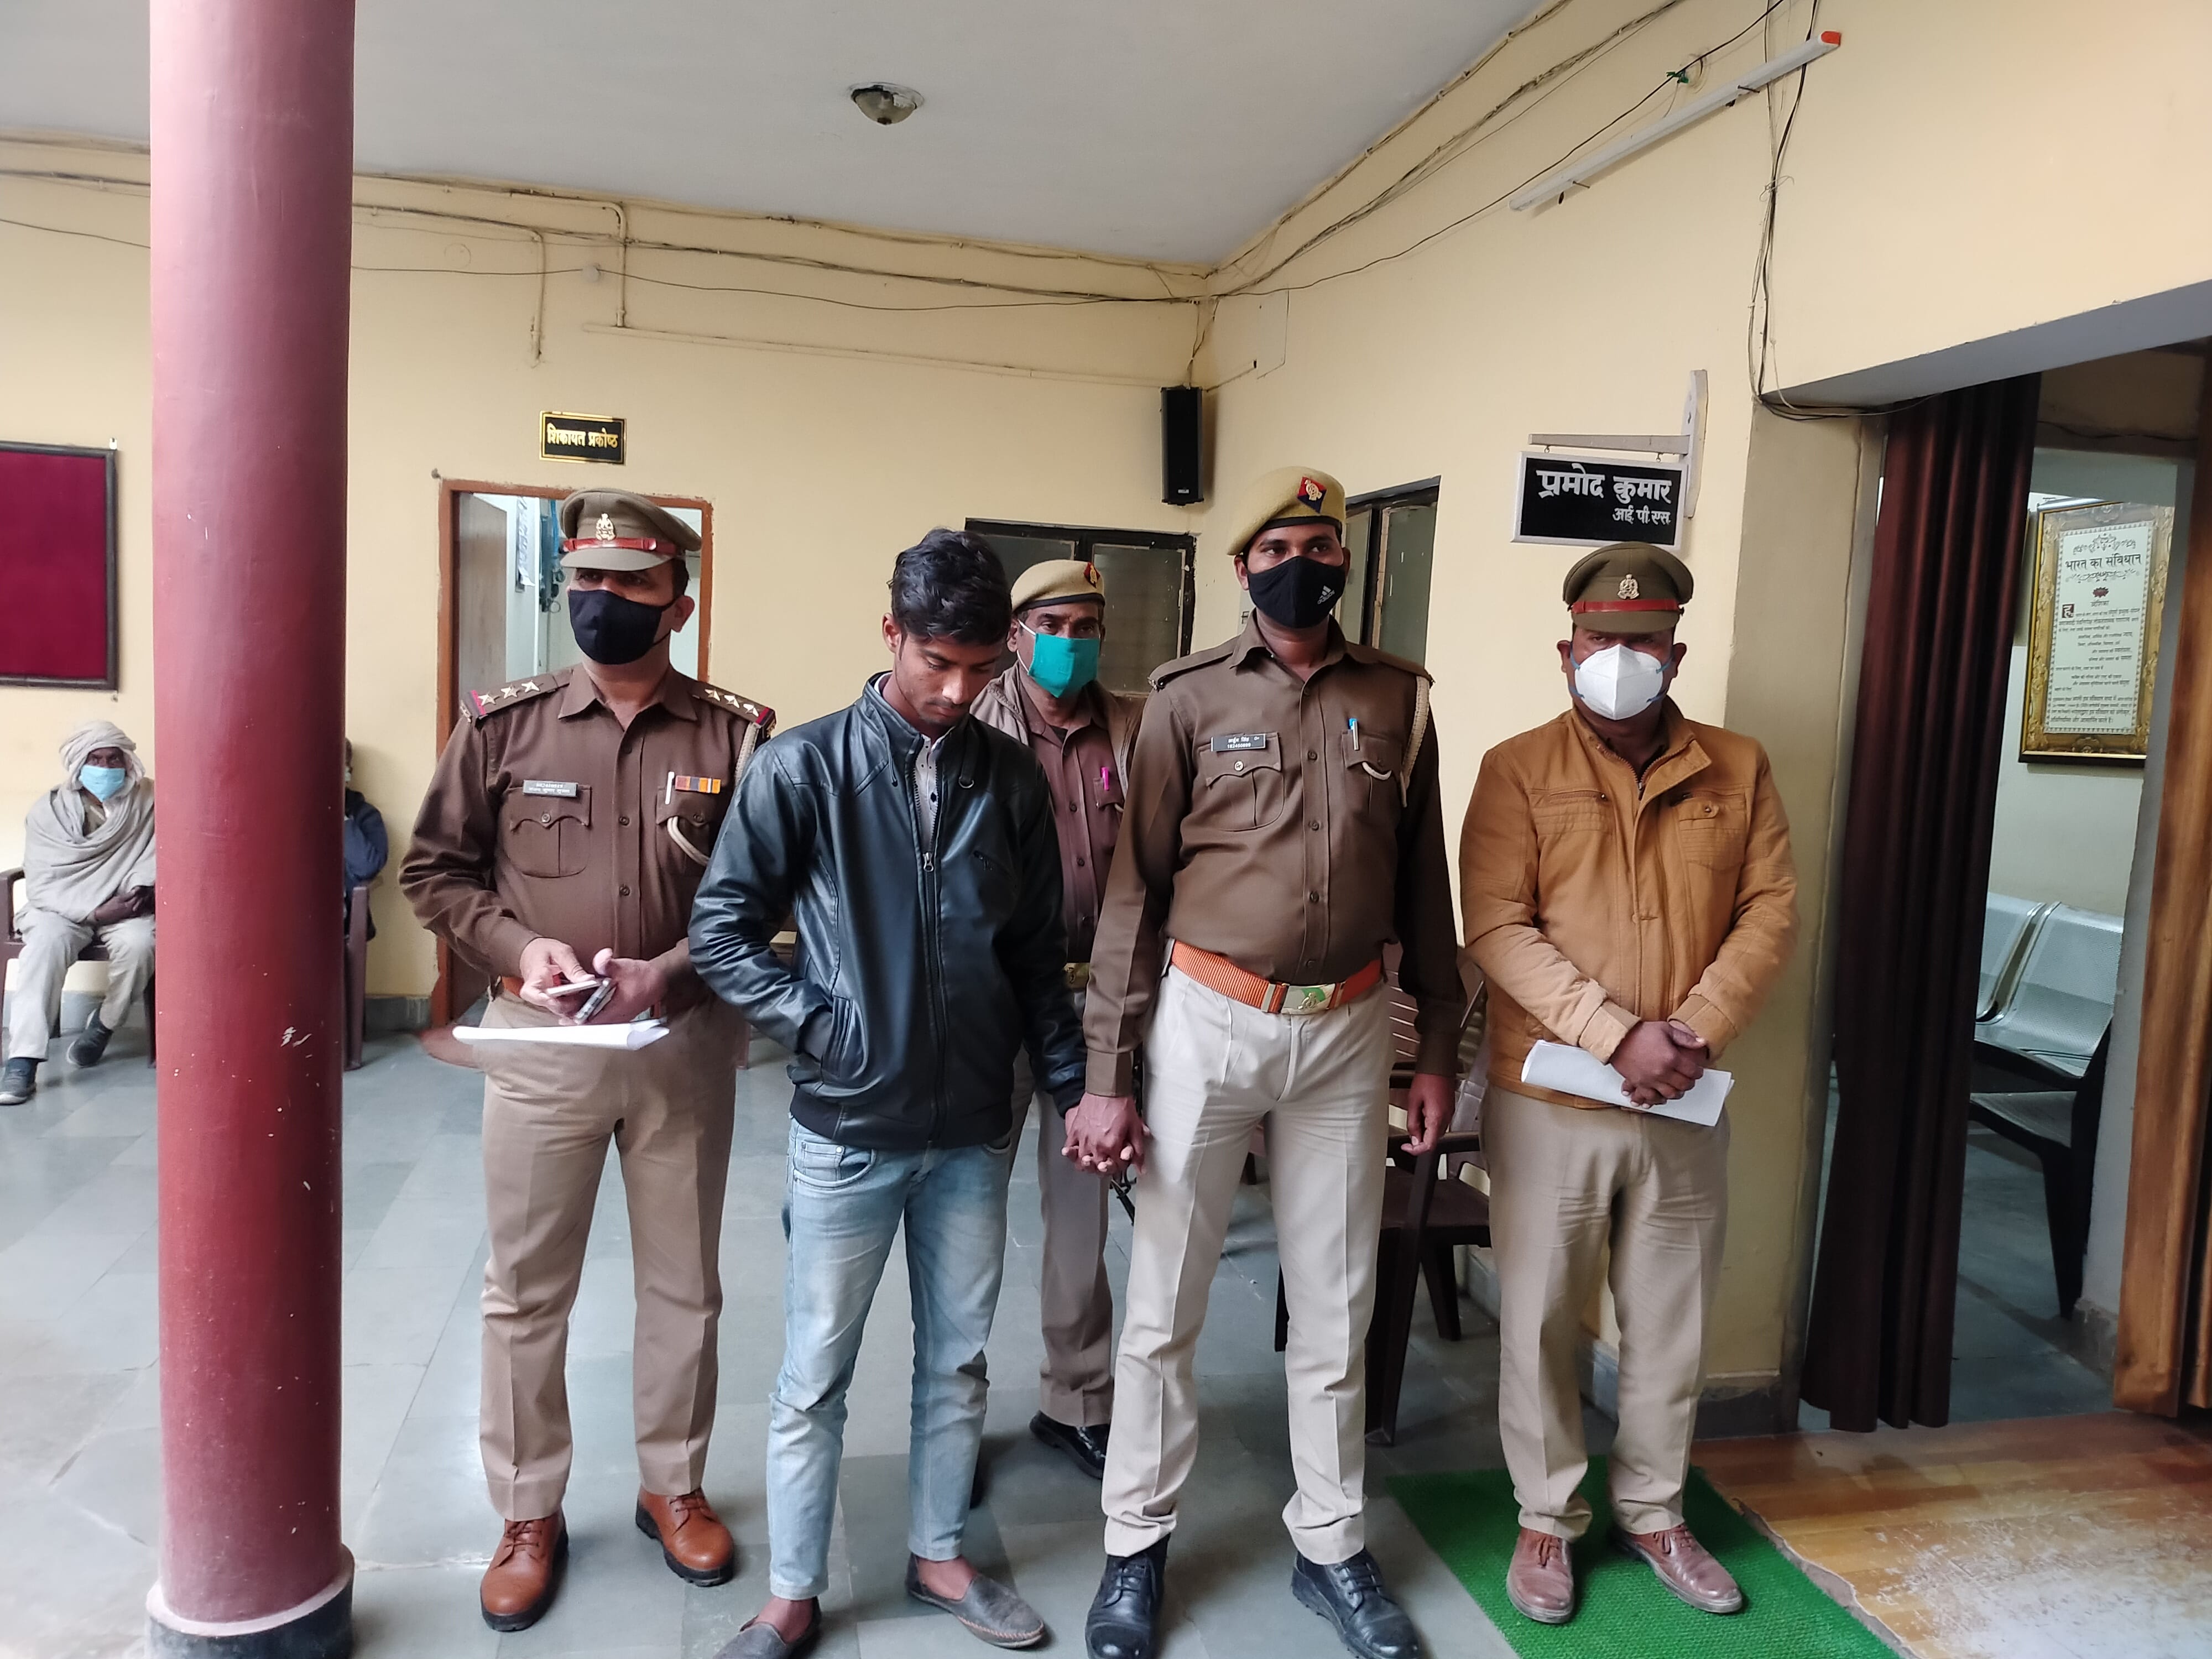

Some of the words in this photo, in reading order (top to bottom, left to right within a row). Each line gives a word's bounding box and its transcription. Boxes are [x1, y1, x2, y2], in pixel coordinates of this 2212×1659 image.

[547, 422, 586, 447] शिकायत
[588, 427, 618, 448] प्रकोष्ठ
[1535, 462, 1605, 498] प्रमोद
[1613, 475, 1672, 504] कुमार
[2065, 559, 2087, 571] भारत
[2089, 557, 2103, 569] का
[2105, 553, 2142, 566] संविधान
